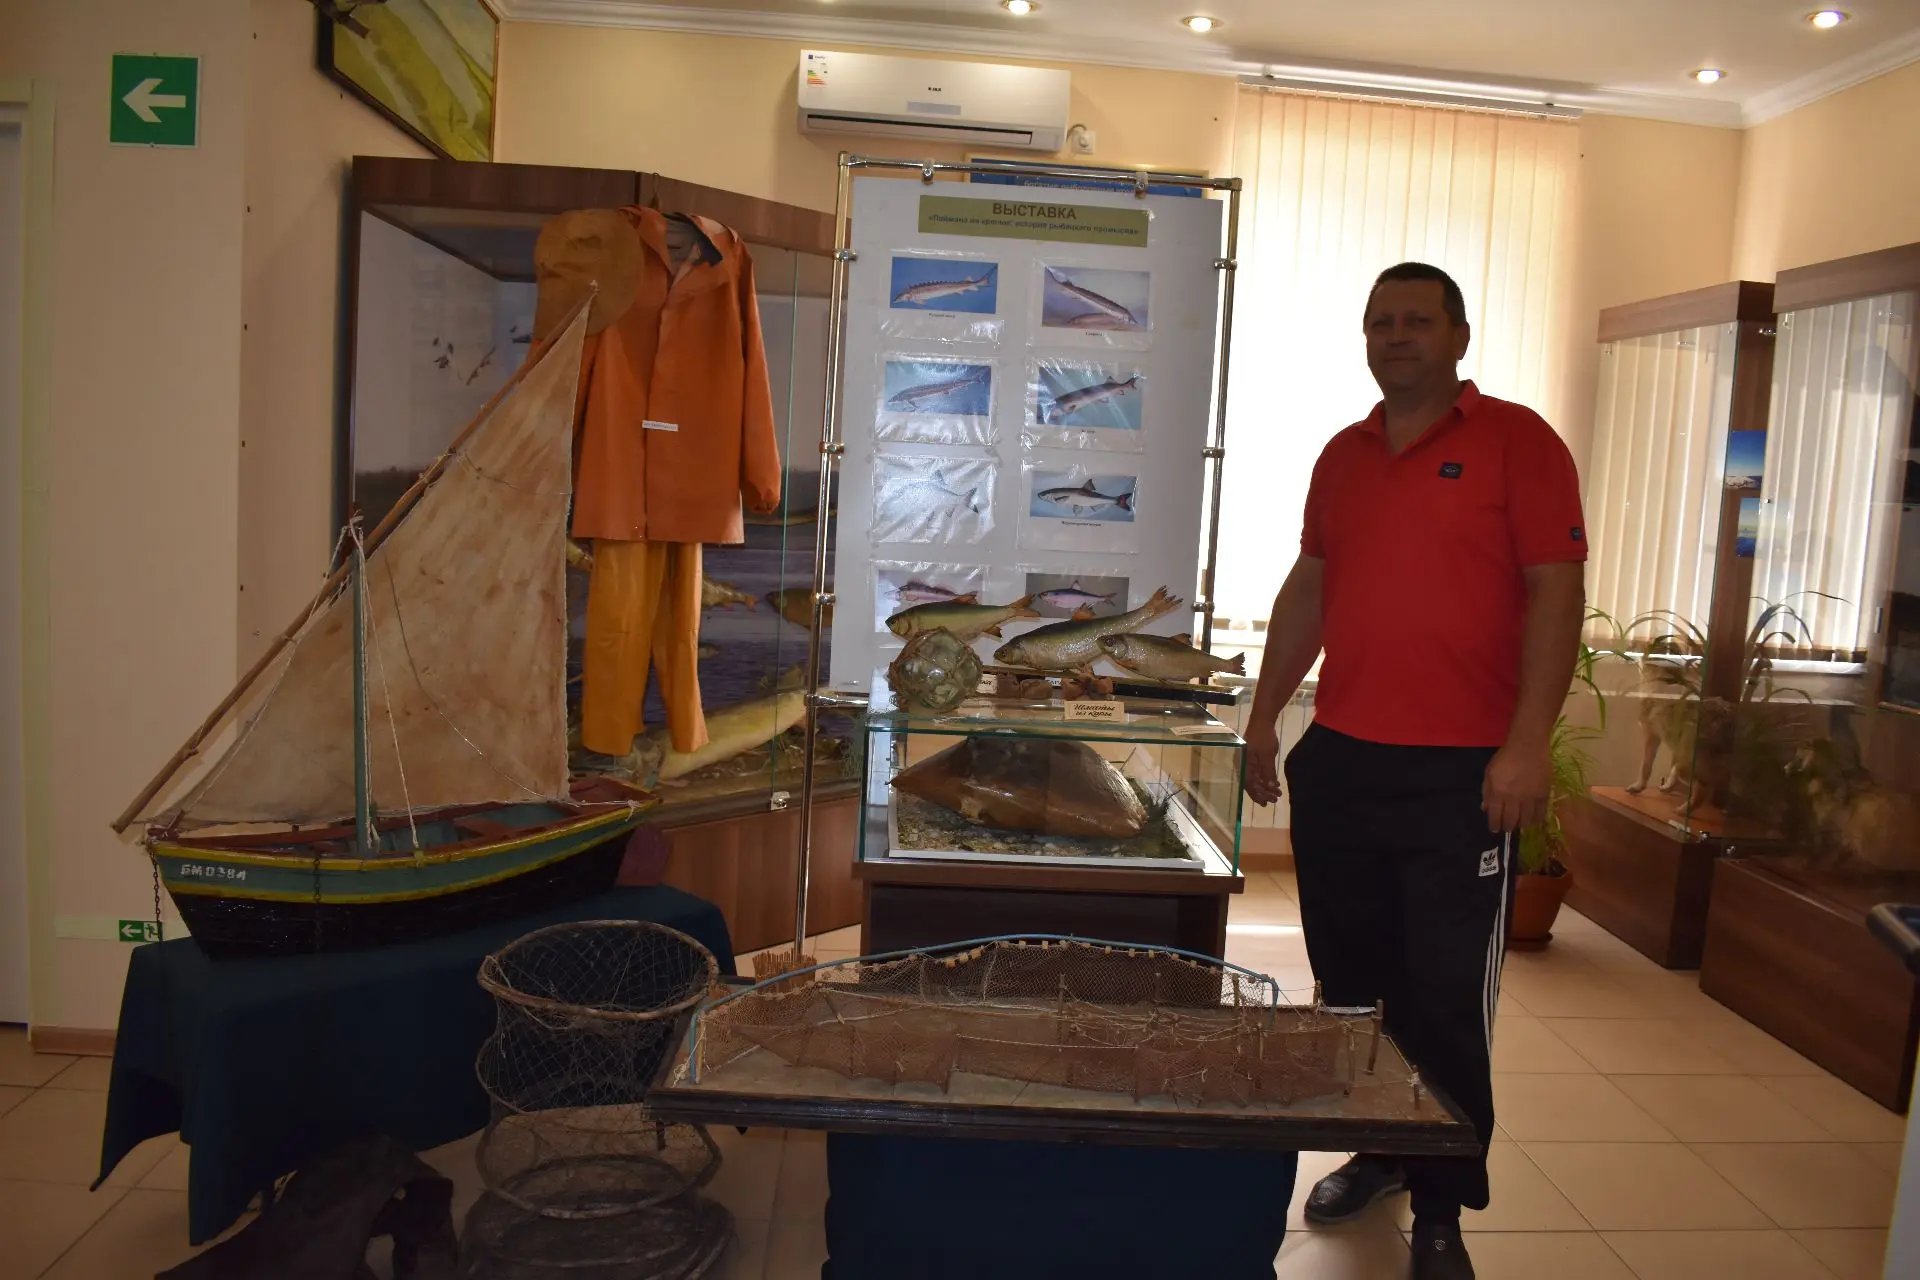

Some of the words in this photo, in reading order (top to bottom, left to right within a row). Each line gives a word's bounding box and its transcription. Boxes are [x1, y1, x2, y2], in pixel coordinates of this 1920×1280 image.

[992, 203, 1077, 220] ВЫСТАВКА
[1015, 219, 1047, 230] история
[1049, 222, 1091, 232] рыбацкого
